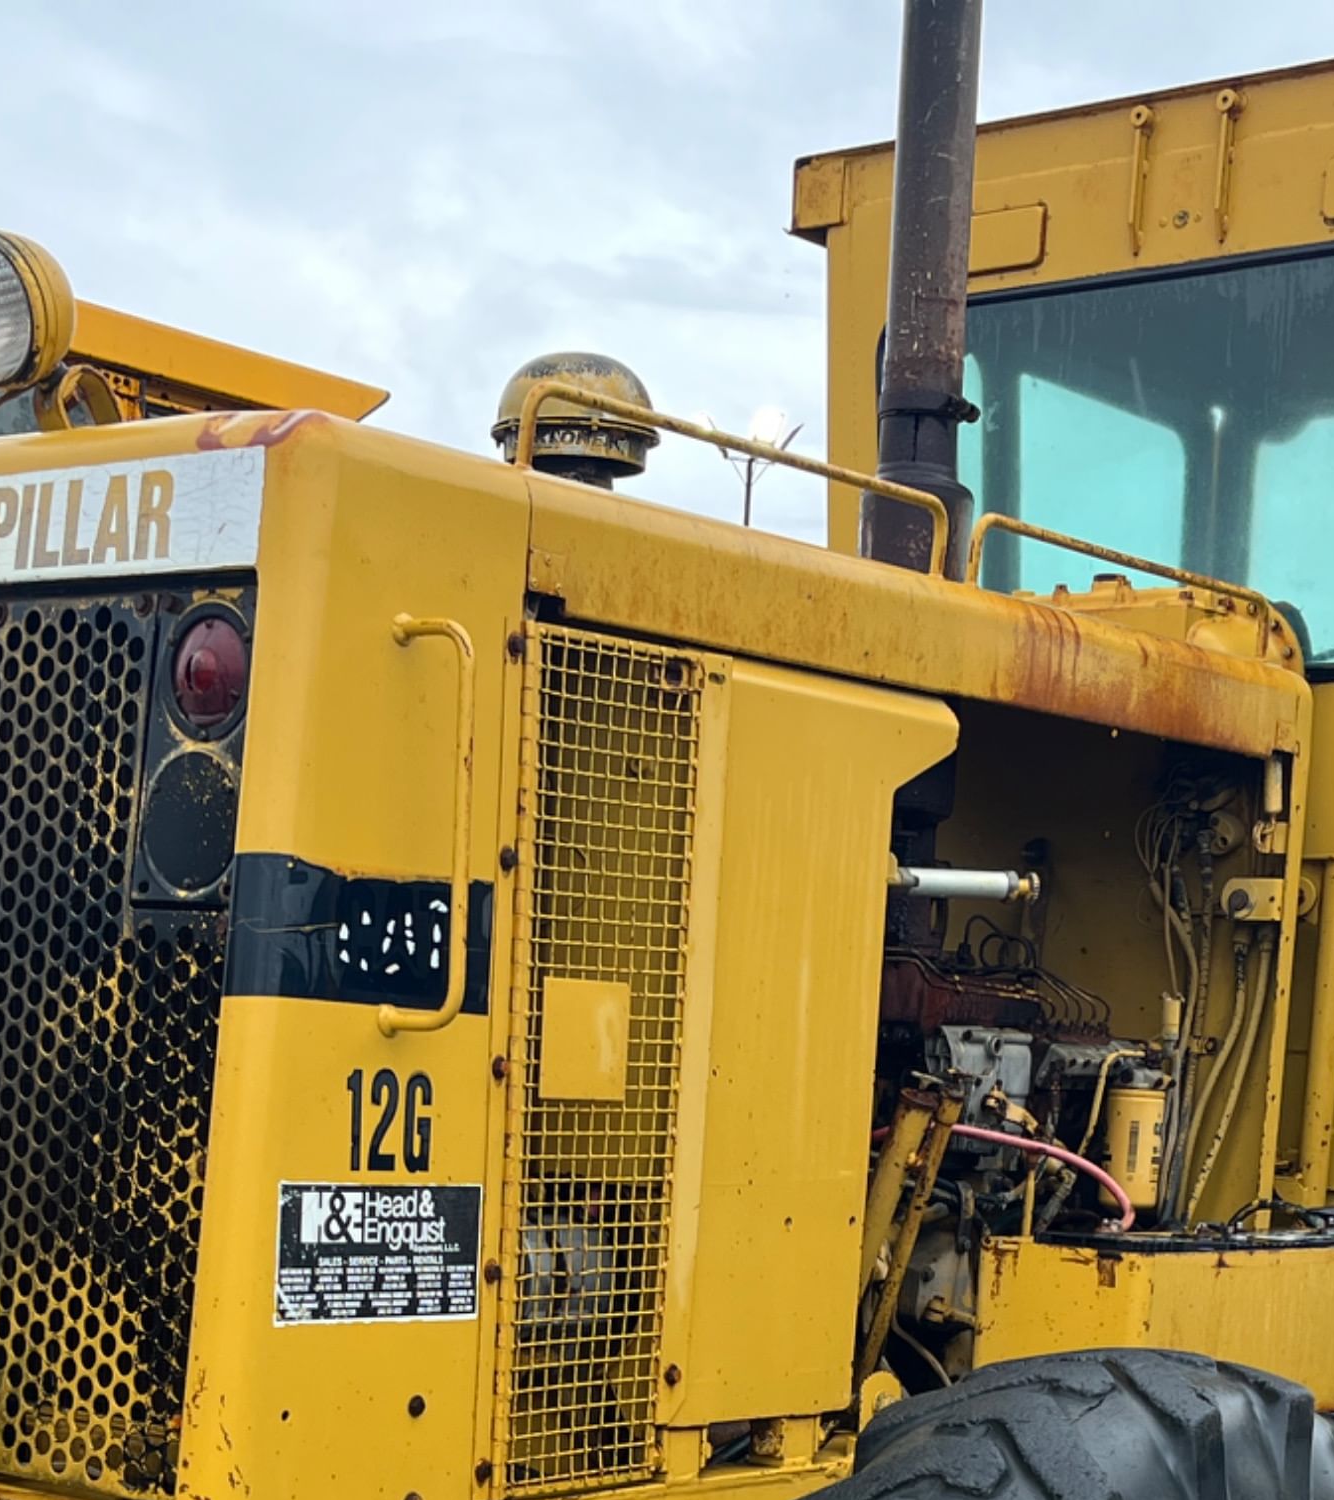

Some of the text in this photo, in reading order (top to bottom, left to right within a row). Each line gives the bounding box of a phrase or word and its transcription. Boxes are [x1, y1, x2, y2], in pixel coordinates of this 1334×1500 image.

[347, 1068, 432, 1173] 12G
[300, 1191, 364, 1243] H&E
[365, 1189, 435, 1217] Head &
[364, 1215, 446, 1251] Engquist
